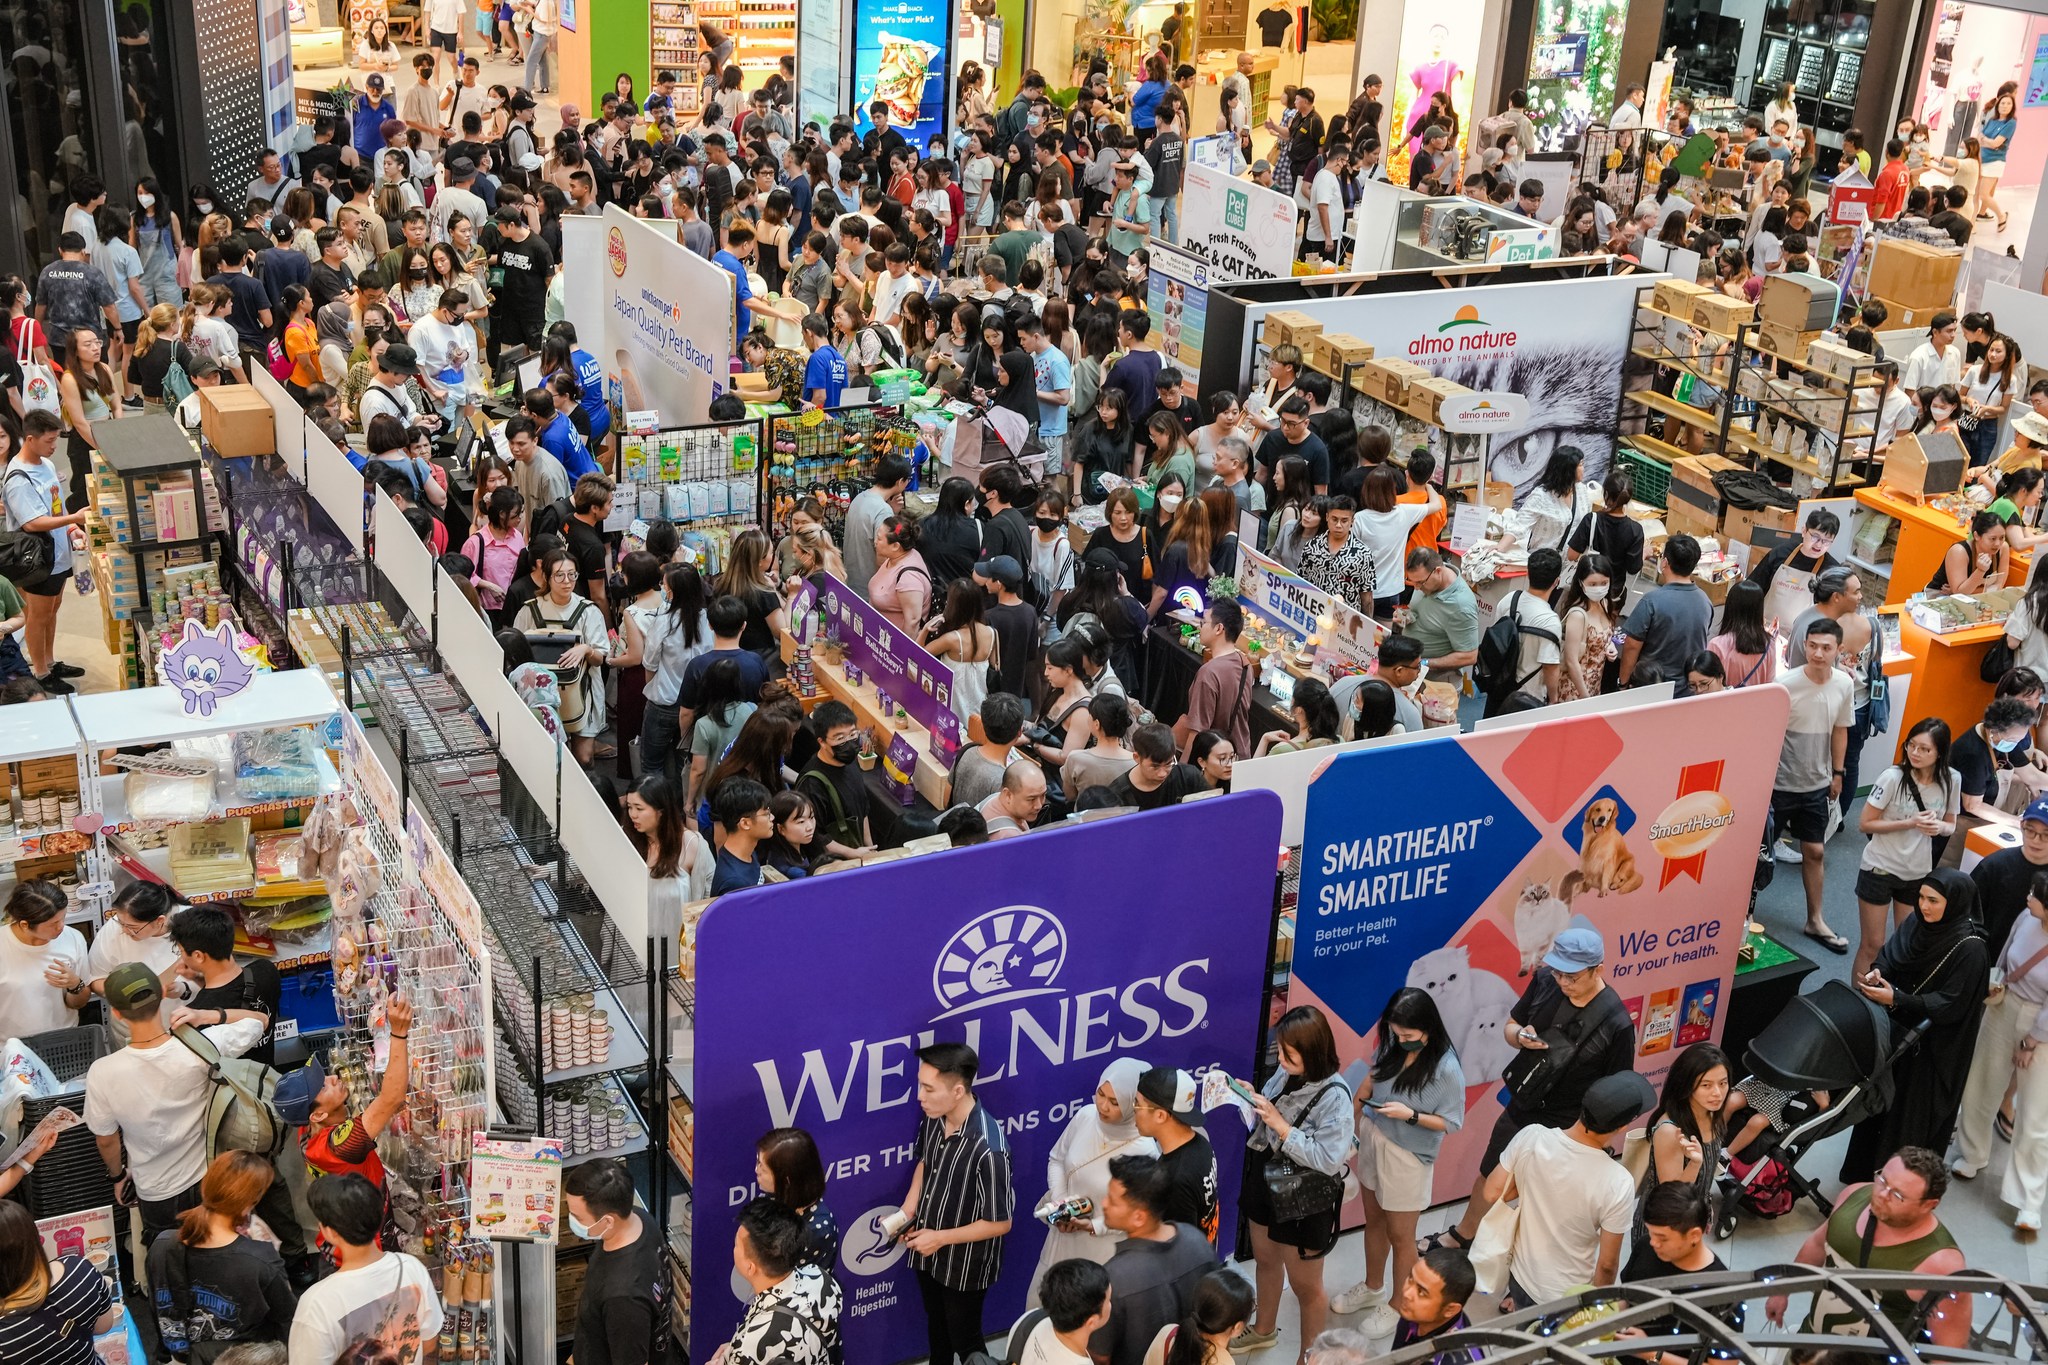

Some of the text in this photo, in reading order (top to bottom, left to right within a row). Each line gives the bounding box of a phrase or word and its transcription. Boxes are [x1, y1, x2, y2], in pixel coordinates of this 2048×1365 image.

[870, 16, 896, 24] What's
[897, 16, 914, 24] Your
[298, 98, 310, 106] MIX
[298, 106, 337, 117] SELECT ITEMS
[296, 116, 311, 125] BUY
[1166, 149, 1181, 158] DEPT
[1229, 192, 1246, 215] Pet
[1227, 211, 1244, 228] CUBES
[502, 251, 530, 263] FIGURES
[608, 242, 627, 266] JAPAN
[1208, 233, 1257, 261] Fresh Frozen
[1511, 248, 1532, 261] Pet
[506, 260, 532, 271] SPEECH
[1212, 250, 1220, 266] &
[1222, 254, 1244, 277] CAT
[49, 270, 84, 279] CAMPING
[641, 287, 673, 319] unicharm pet
[614, 289, 713, 376] Japan Quality Pet Brand
[1408, 330, 1517, 356] almo nature
[1457, 355, 1472, 363] THE
[1477, 351, 1515, 360] ANIMALS
[665, 355, 676, 369] Good
[676, 362, 690, 380] Quality
[1459, 410, 1510, 420] almo nature
[1777, 581, 1791, 589] almo
[1477, 600, 1493, 613] ture
[865, 636, 879, 654] Stella
[883, 652, 903, 675] Chewy's
[1337, 633, 1379, 660] Healthy Choice
[1339, 647, 1359, 666] Healthy
[111, 757, 208, 777] CattyMan
[1871, 784, 1884, 800] 72
[226, 802, 289, 819] PURCHASE
[1649, 810, 1735, 841] SmartHeart
[212, 892, 228, 902] TO
[233, 888, 254, 898] ENJ
[1318, 862, 1451, 916] SMARTLIFE
[1315, 916, 1397, 942] Better Health
[1619, 919, 1721, 958] We care
[1314, 934, 1390, 958] for your Pet.
[1613, 944, 1719, 978] for your health.
[752, 958, 1210, 1130] WELNESS
[728, 1097, 1083, 1207] DIVER TH GNS OF
[856, 1281, 895, 1301] Healthy
[197, 1293, 236, 1316] COUNTY
[851, 1296, 898, 1317] Digestion
